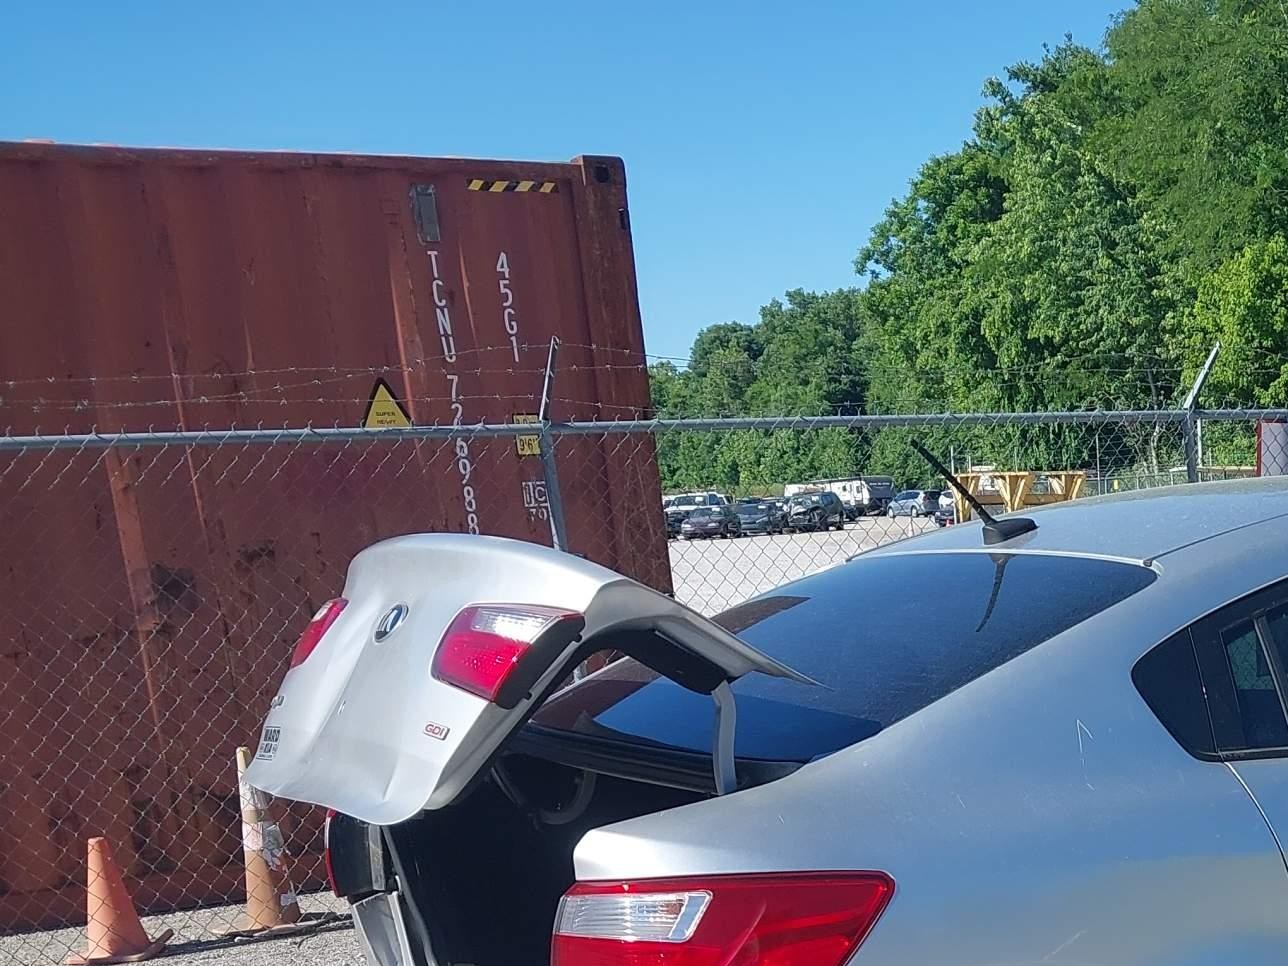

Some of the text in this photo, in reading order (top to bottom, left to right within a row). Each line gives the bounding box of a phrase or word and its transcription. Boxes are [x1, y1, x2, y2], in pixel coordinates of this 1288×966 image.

[427, 251, 456, 362] TCNU
[497, 252, 519, 362] 45G1
[425, 723, 446, 736] GDI
